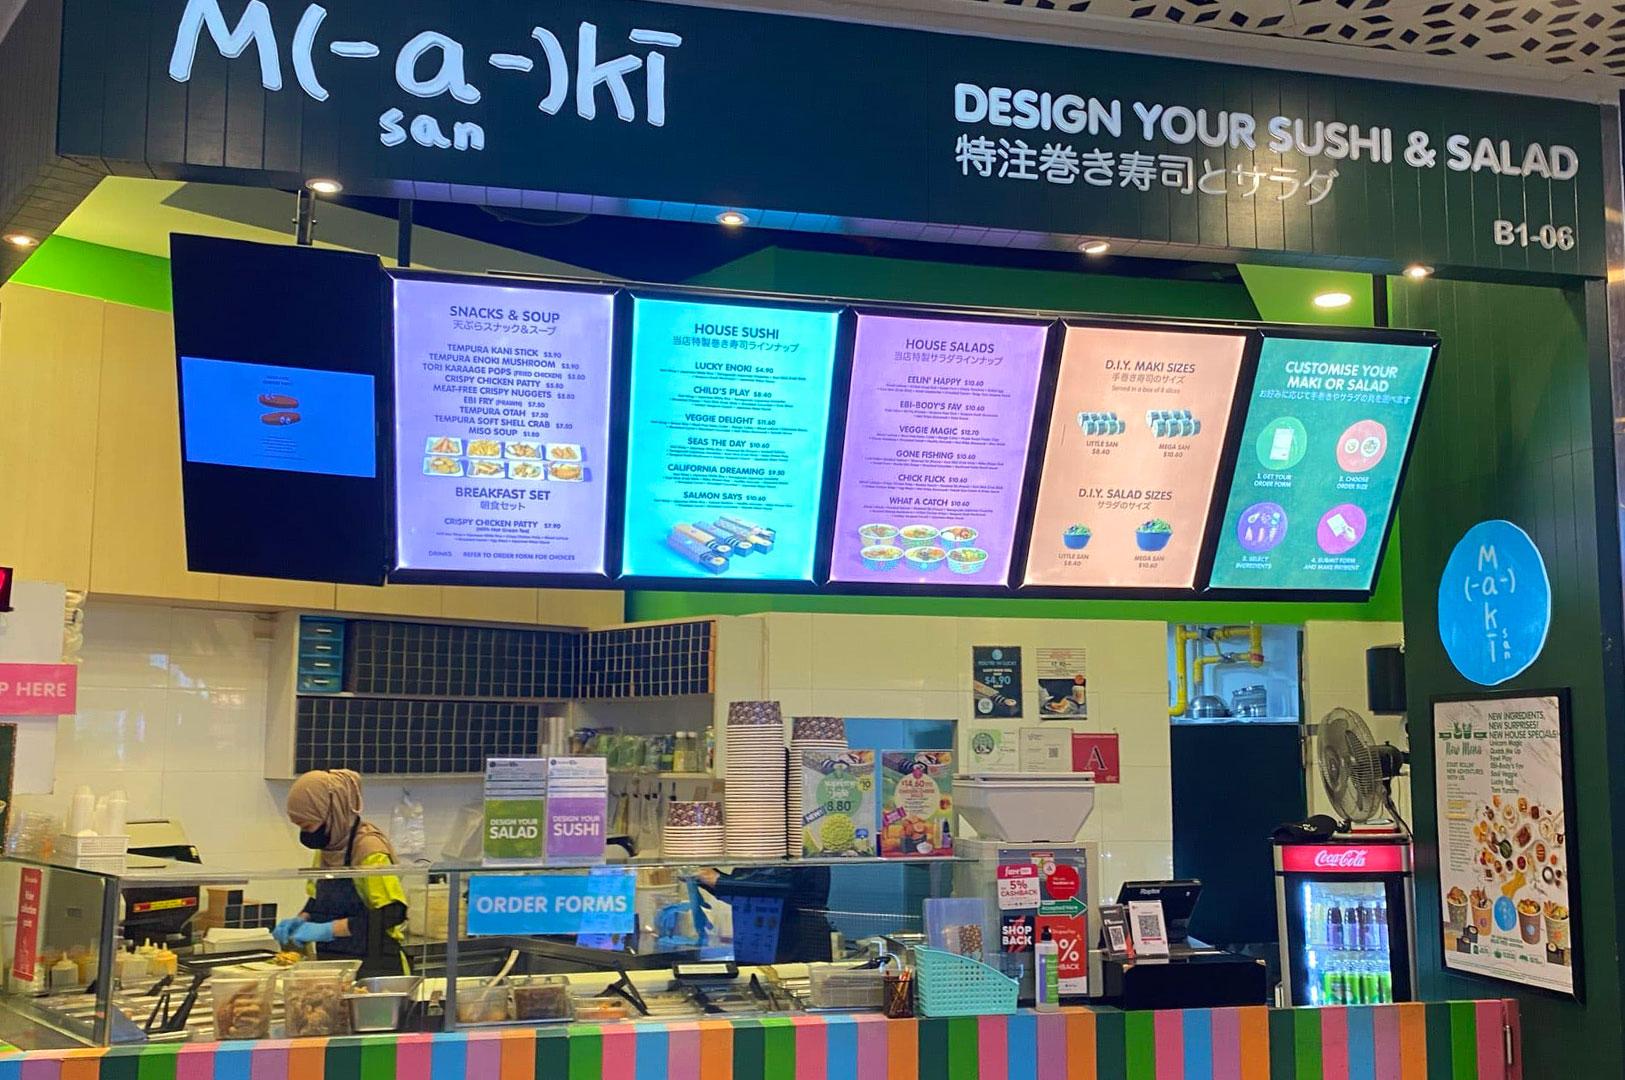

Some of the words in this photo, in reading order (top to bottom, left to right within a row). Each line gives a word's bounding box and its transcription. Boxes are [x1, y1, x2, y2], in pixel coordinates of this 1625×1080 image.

[379, 107, 485, 151] san
[954, 83, 1122, 138] DESIGN
[1133, 101, 1256, 150] YOUR
[1268, 116, 1392, 164] SUSHI
[1404, 130, 1436, 168] &
[1446, 134, 1579, 180] SALAD
[955, 133, 1339, 206] 特注巻き寿司とサラダ
[1493, 219, 1575, 251] B1-06
[450, 306, 503, 319] SNACKS
[508, 310, 518, 321] &
[523, 311, 560, 323] SOUP
[695, 323, 737, 337] HOUSE
[742, 327, 779, 339] SUSHI
[447, 344, 489, 354] TEMPURA
[491, 347, 513, 355] KANI
[514, 348, 539, 357] STICK
[906, 339, 947, 351] HOUSE
[950, 341, 995, 353] SALADS
[429, 353, 471, 363] TEMPURA
[473, 356, 499, 364] ENOKI
[502, 358, 556, 368] MUSHROOM
[1106, 360, 1131, 371] D.I.Y.
[1135, 362, 1164, 372] MAKI
[1167, 363, 1196, 373] SIZES
[423, 363, 442, 371] TORI
[445, 364, 486, 374] KARAAGE
[488, 368, 511, 376] POPS
[695, 362, 723, 371] LUCKY
[725, 364, 752, 372] ENOKI
[1285, 361, 1359, 376] CUSTOMISE
[1362, 365, 1398, 378] YOUR
[445, 375, 474, 384] CRISPY
[477, 377, 514, 386] CHICKEN
[517, 379, 541, 388] PATTY
[933, 377, 961, 386] HAPPY
[1287, 376, 1321, 388] MAKI
[1325, 378, 1343, 390] OR
[1347, 379, 1389, 392] SALAD
[433, 385, 477, 394] MEAT-FREE
[480, 387, 509, 396] CRISPY
[511, 390, 551, 398] NUGGETS
[694, 386, 726, 395] CHILD'S
[729, 388, 750, 397] PLAY
[479, 397, 494, 405] FRY
[900, 401, 945, 410] EBI-BODY'S
[948, 403, 962, 411] FAV
[460, 407, 500, 415] TEMPURA
[503, 409, 526, 417] OTAH
[435, 415, 475, 424] TEMPURA
[478, 417, 498, 426] SOFT
[501, 419, 525, 427] SHELL
[528, 421, 550, 429] CRAB
[685, 414, 716, 423] VEGGIE
[719, 416, 754, 425] DELIGHT
[469, 427, 491, 435] MISO
[494, 428, 517, 436] SOUP
[899, 425, 928, 434] VEGGIE
[930, 427, 958, 435] MAGIC
[688, 437, 708, 446] SEAS
[711, 439, 726, 447] THE
[896, 450, 920, 458] GONE
[922, 451, 954, 460] FISHING
[668, 464, 717, 473] CALIFORNIA
[720, 467, 765, 476] DREAMING
[898, 474, 922, 482] CHICK
[924, 475, 945, 483] FLICK
[456, 488, 525, 499] BREAKFAST
[529, 491, 550, 500] SET
[684, 491, 720, 500] SALMON
[722, 493, 742, 501] SAYS
[1079, 488, 1103, 498] D.I.Y.
[1107, 490, 1142, 500] SALAD
[1144, 491, 1172, 501] SIZES
[890, 497, 912, 505] WHAT
[923, 498, 948, 507] CATCH
[444, 518, 473, 526] CRISPY
[985, 676, 1011, 684] $4.90
[16, 682, 67, 697] HERE
[1504, 721, 1539, 729] SURPRISES!
[1085, 745, 1107, 770] A
[490, 818, 516, 826] DESIGN
[490, 826, 538, 839] SALAD
[553, 823, 599, 836] SUSHI
[1315, 850, 1368, 867] Coca-Cola
[1010, 881, 1028, 889] 5%
[1001, 888, 1037, 897] CASHBACK
[476, 896, 548, 913] ORDER
[555, 895, 627, 912] FORMS
[1002, 926, 1032, 934] SHOP
[1002, 936, 1032, 945] BACK
